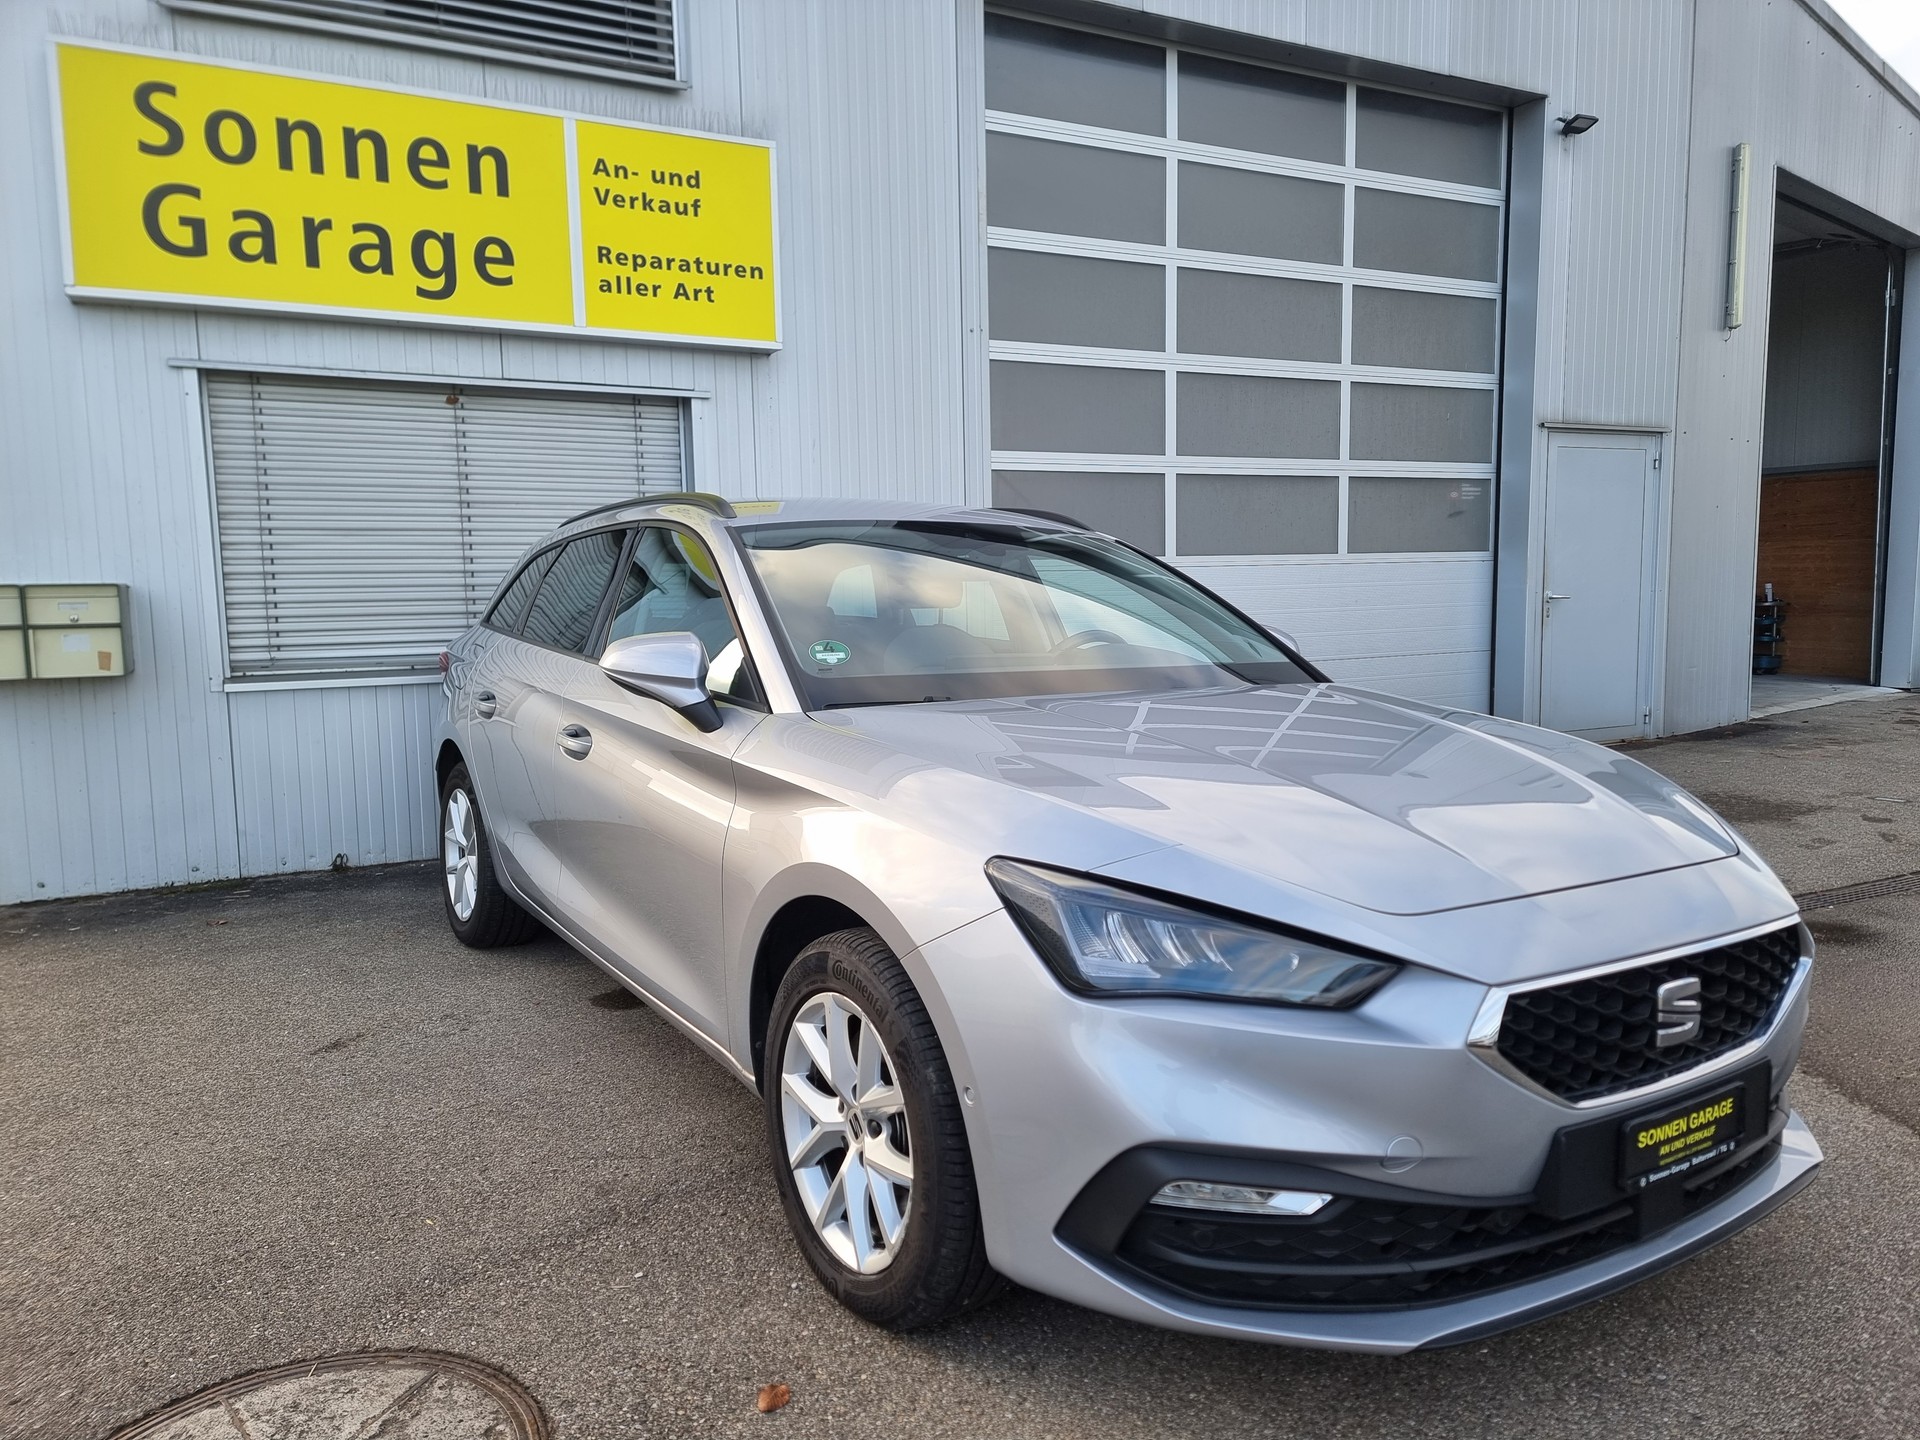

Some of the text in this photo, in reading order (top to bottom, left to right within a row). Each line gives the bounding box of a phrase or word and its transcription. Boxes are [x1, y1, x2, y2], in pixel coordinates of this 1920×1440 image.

[134, 81, 511, 198] Sonnen
[592, 158, 701, 190] An- und
[593, 186, 702, 218] Verkauf
[142, 183, 515, 301] Garage
[597, 245, 764, 280] Reparaturen
[598, 275, 715, 303] aller Art
[822, 641, 835, 653] 4
[832, 960, 889, 1023] Continental
[1637, 1098, 1734, 1148] SONNEN GARAGE
[1659, 1144, 1671, 1156] AN
[1671, 1138, 1686, 1152] UND
[1686, 1125, 1717, 1145] VERKAUF
